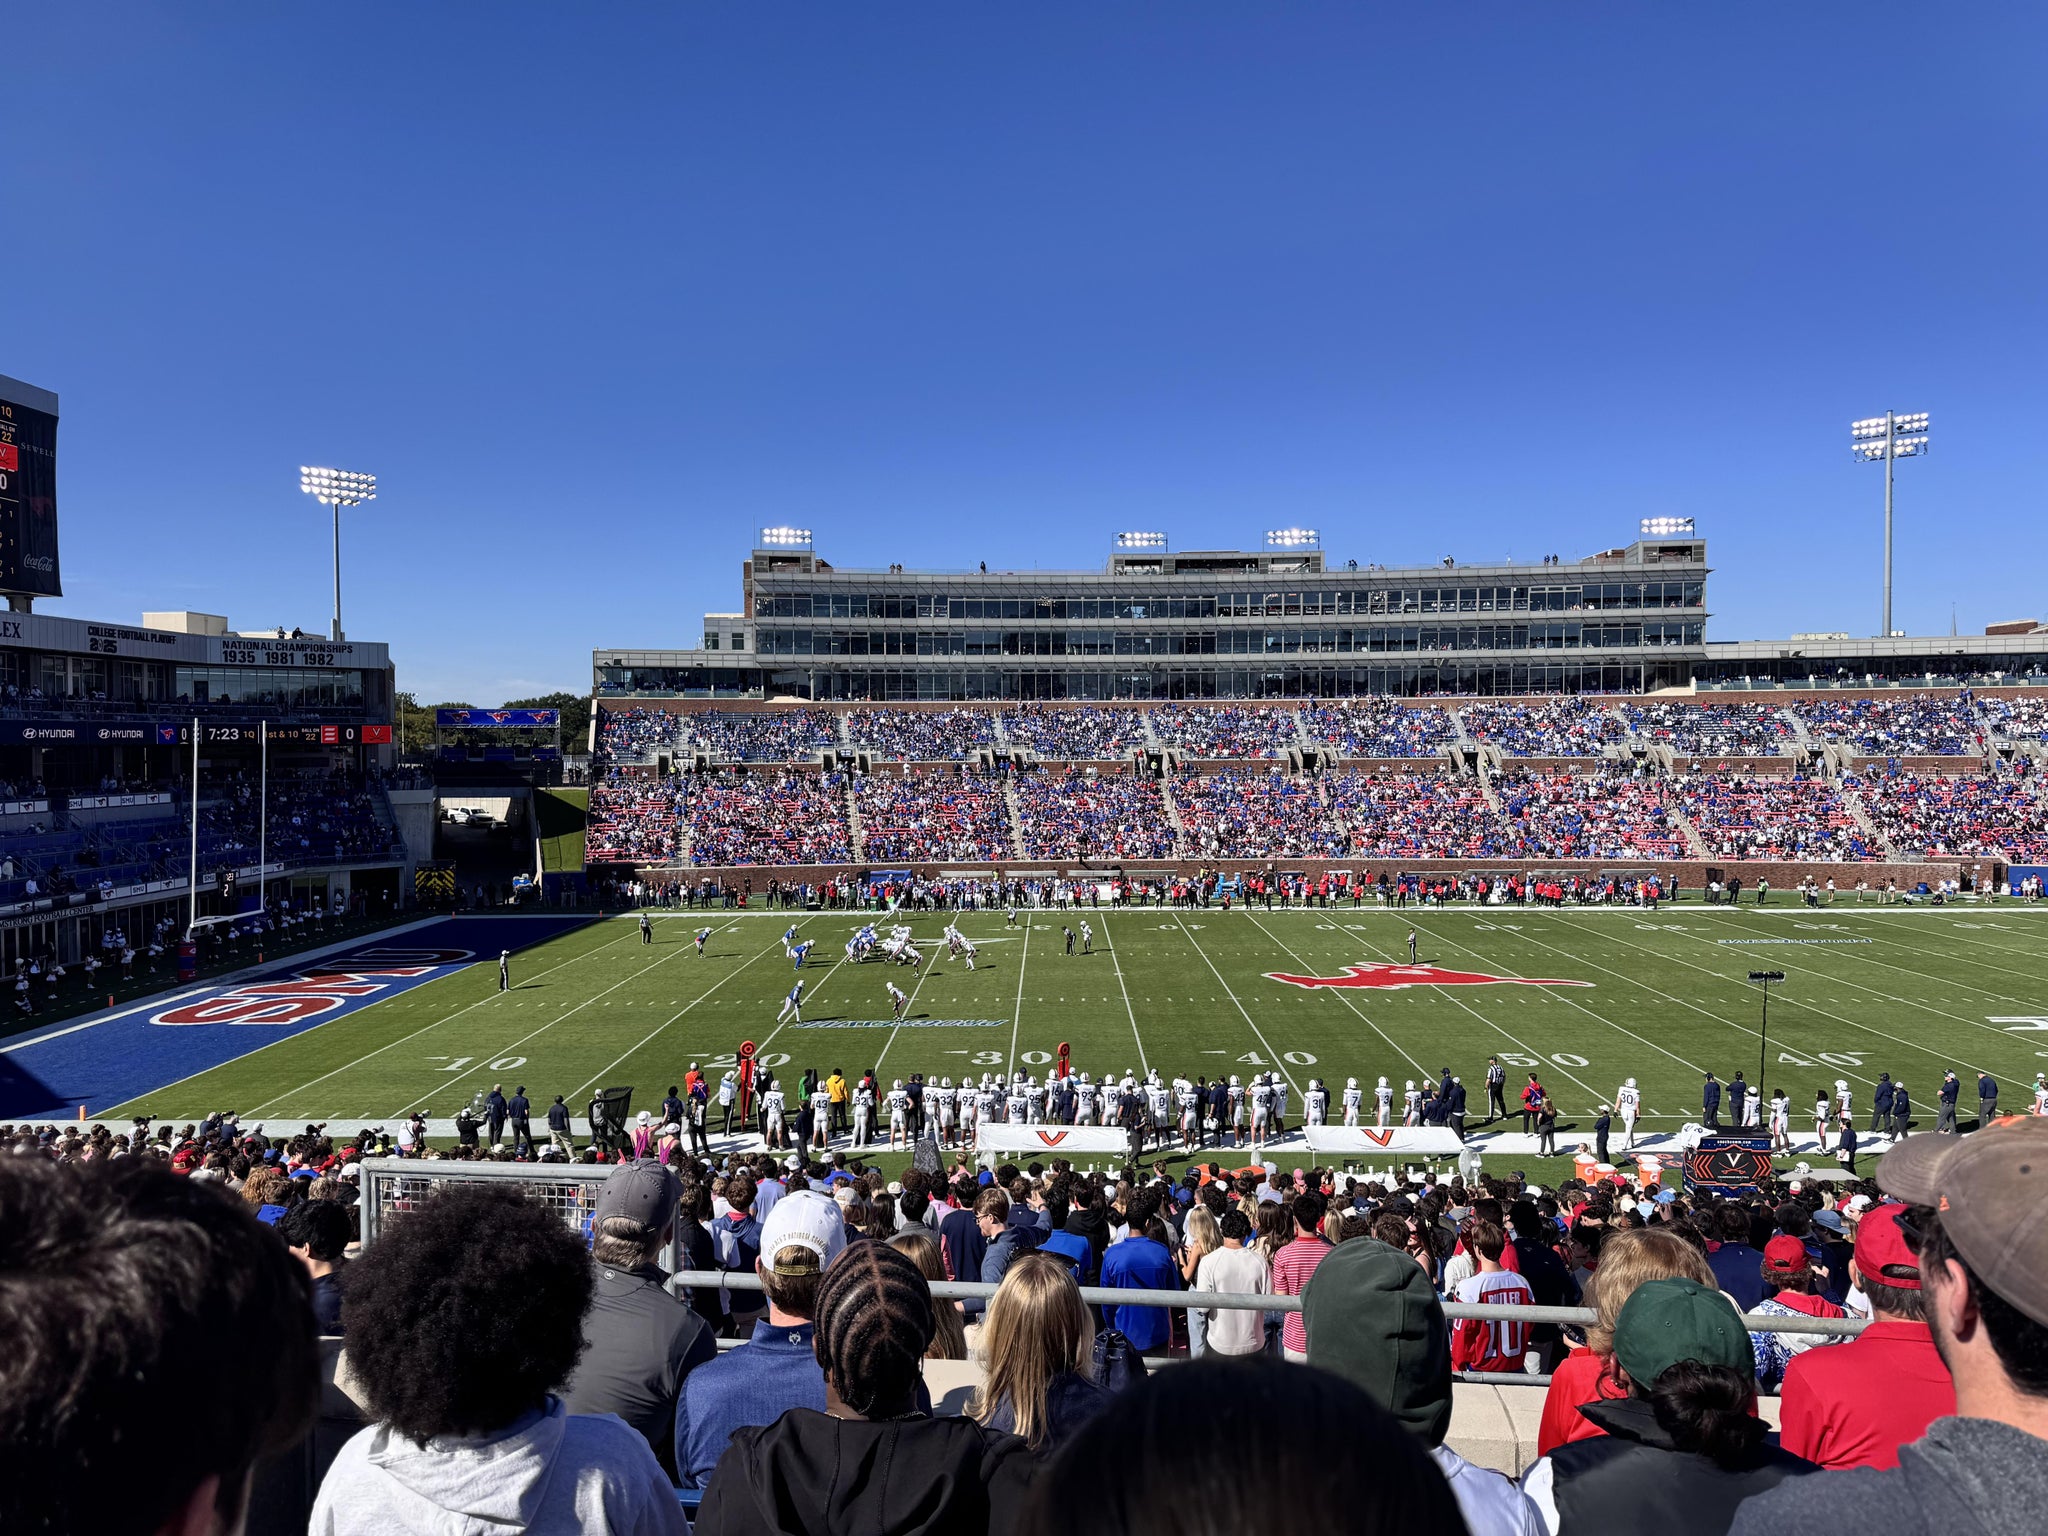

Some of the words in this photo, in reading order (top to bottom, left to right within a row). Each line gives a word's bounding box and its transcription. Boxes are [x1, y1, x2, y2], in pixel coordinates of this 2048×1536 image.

[1, 431, 12, 442] 22
[21, 442, 55, 457] SEWELL
[0, 621, 21, 638] EX
[88, 626, 116, 638] COLLEGE
[117, 629, 149, 642] FOOTBALL
[151, 633, 176, 644] PLAYOFF
[222, 640, 272, 651] NATIONAL
[276, 642, 353, 654] CHAMPIONSHIPS
[222, 650, 255, 664] 1935
[265, 652, 294, 665] 1981
[303, 653, 334, 666] 1982
[38, 729, 75, 739] HYUNDAI
[111, 730, 143, 739] HYUNDAI
[181, 728, 187, 740] 0
[208, 728, 239, 740] 7:23
[243, 731, 255, 739] 1Q
[288, 730, 299, 738] 10
[305, 733, 316, 741] 22
[346, 728, 354, 740] 0
[69, 800, 82, 808] SMU
[121, 797, 133, 805] SMU
[132, 885, 145, 894] SMU
[34, 909, 68, 922] FOOTBALL
[70, 904, 94, 916] CENTER
[149, 948, 476, 1025] SMU
[971, 1050, 1052, 1065] 30
[1236, 1051, 1317, 1065] 40
[1498, 1053, 1589, 1067] 50
[1777, 1052, 1864, 1067] 40
[434, 1056, 527, 1071] 10
[941, 1095, 952, 1105] 32
[962, 1096, 974, 1106] 92
[1081, 1092, 1092, 1101] 93
[1107, 1092, 1117, 1101] 19
[1352, 1096, 1358, 1106] 7
[1384, 1095, 1389, 1104] 3
[1621, 1093, 1634, 1104] 30
[767, 1098, 779, 1109] 39
[816, 1099, 828, 1108] 43
[892, 1097, 904, 1108] 25
[979, 1101, 991, 1112] 49
[1312, 1098, 1321, 1108] 31
[1011, 1104, 1023, 1114] 36
[1488, 1291, 1520, 1305] BUTLER
[1485, 1320, 1523, 1359] 10
